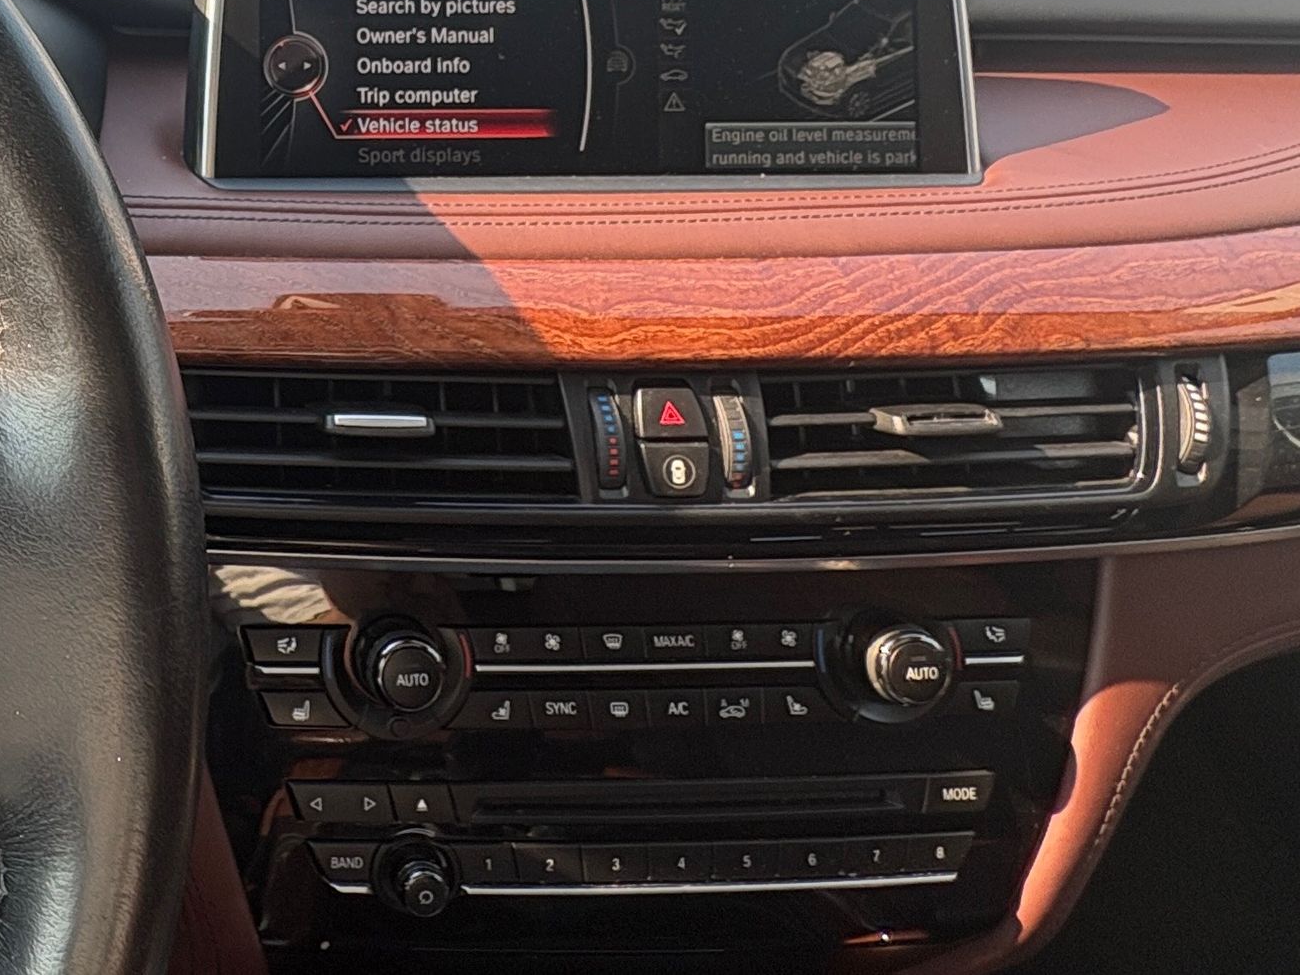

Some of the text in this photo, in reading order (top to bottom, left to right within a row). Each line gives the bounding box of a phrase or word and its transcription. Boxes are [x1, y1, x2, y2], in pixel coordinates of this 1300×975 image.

[356, 27, 495, 44] Owner's Manual
[357, 57, 471, 74] Onboard info
[356, 87, 478, 107] Trip computer
[357, 117, 479, 133] Vehicle status
[711, 128, 765, 145] Engine
[769, 129, 788, 142] oil
[793, 128, 827, 142] level
[358, 147, 481, 165] Sport displays
[713, 152, 772, 166] running
[776, 151, 804, 164] and
[809, 150, 863, 164] vehicle
[868, 150, 880, 163] is
[396, 673, 429, 687] AUTO
[905, 665, 939, 681] AUTO
[545, 702, 577, 715] SYNC
[668, 701, 689, 715] A/C
[942, 787, 977, 801] MODE
[808, 853, 817, 866] 6
[873, 850, 881, 863] 7
[935, 846, 945, 859] 8
[330, 856, 364, 870] BAND
[485, 859, 492, 871] 1
[545, 859, 555, 871] 2
[611, 858, 620, 871] 3
[677, 857, 686, 869] 4
[742, 855, 751, 868] 5
